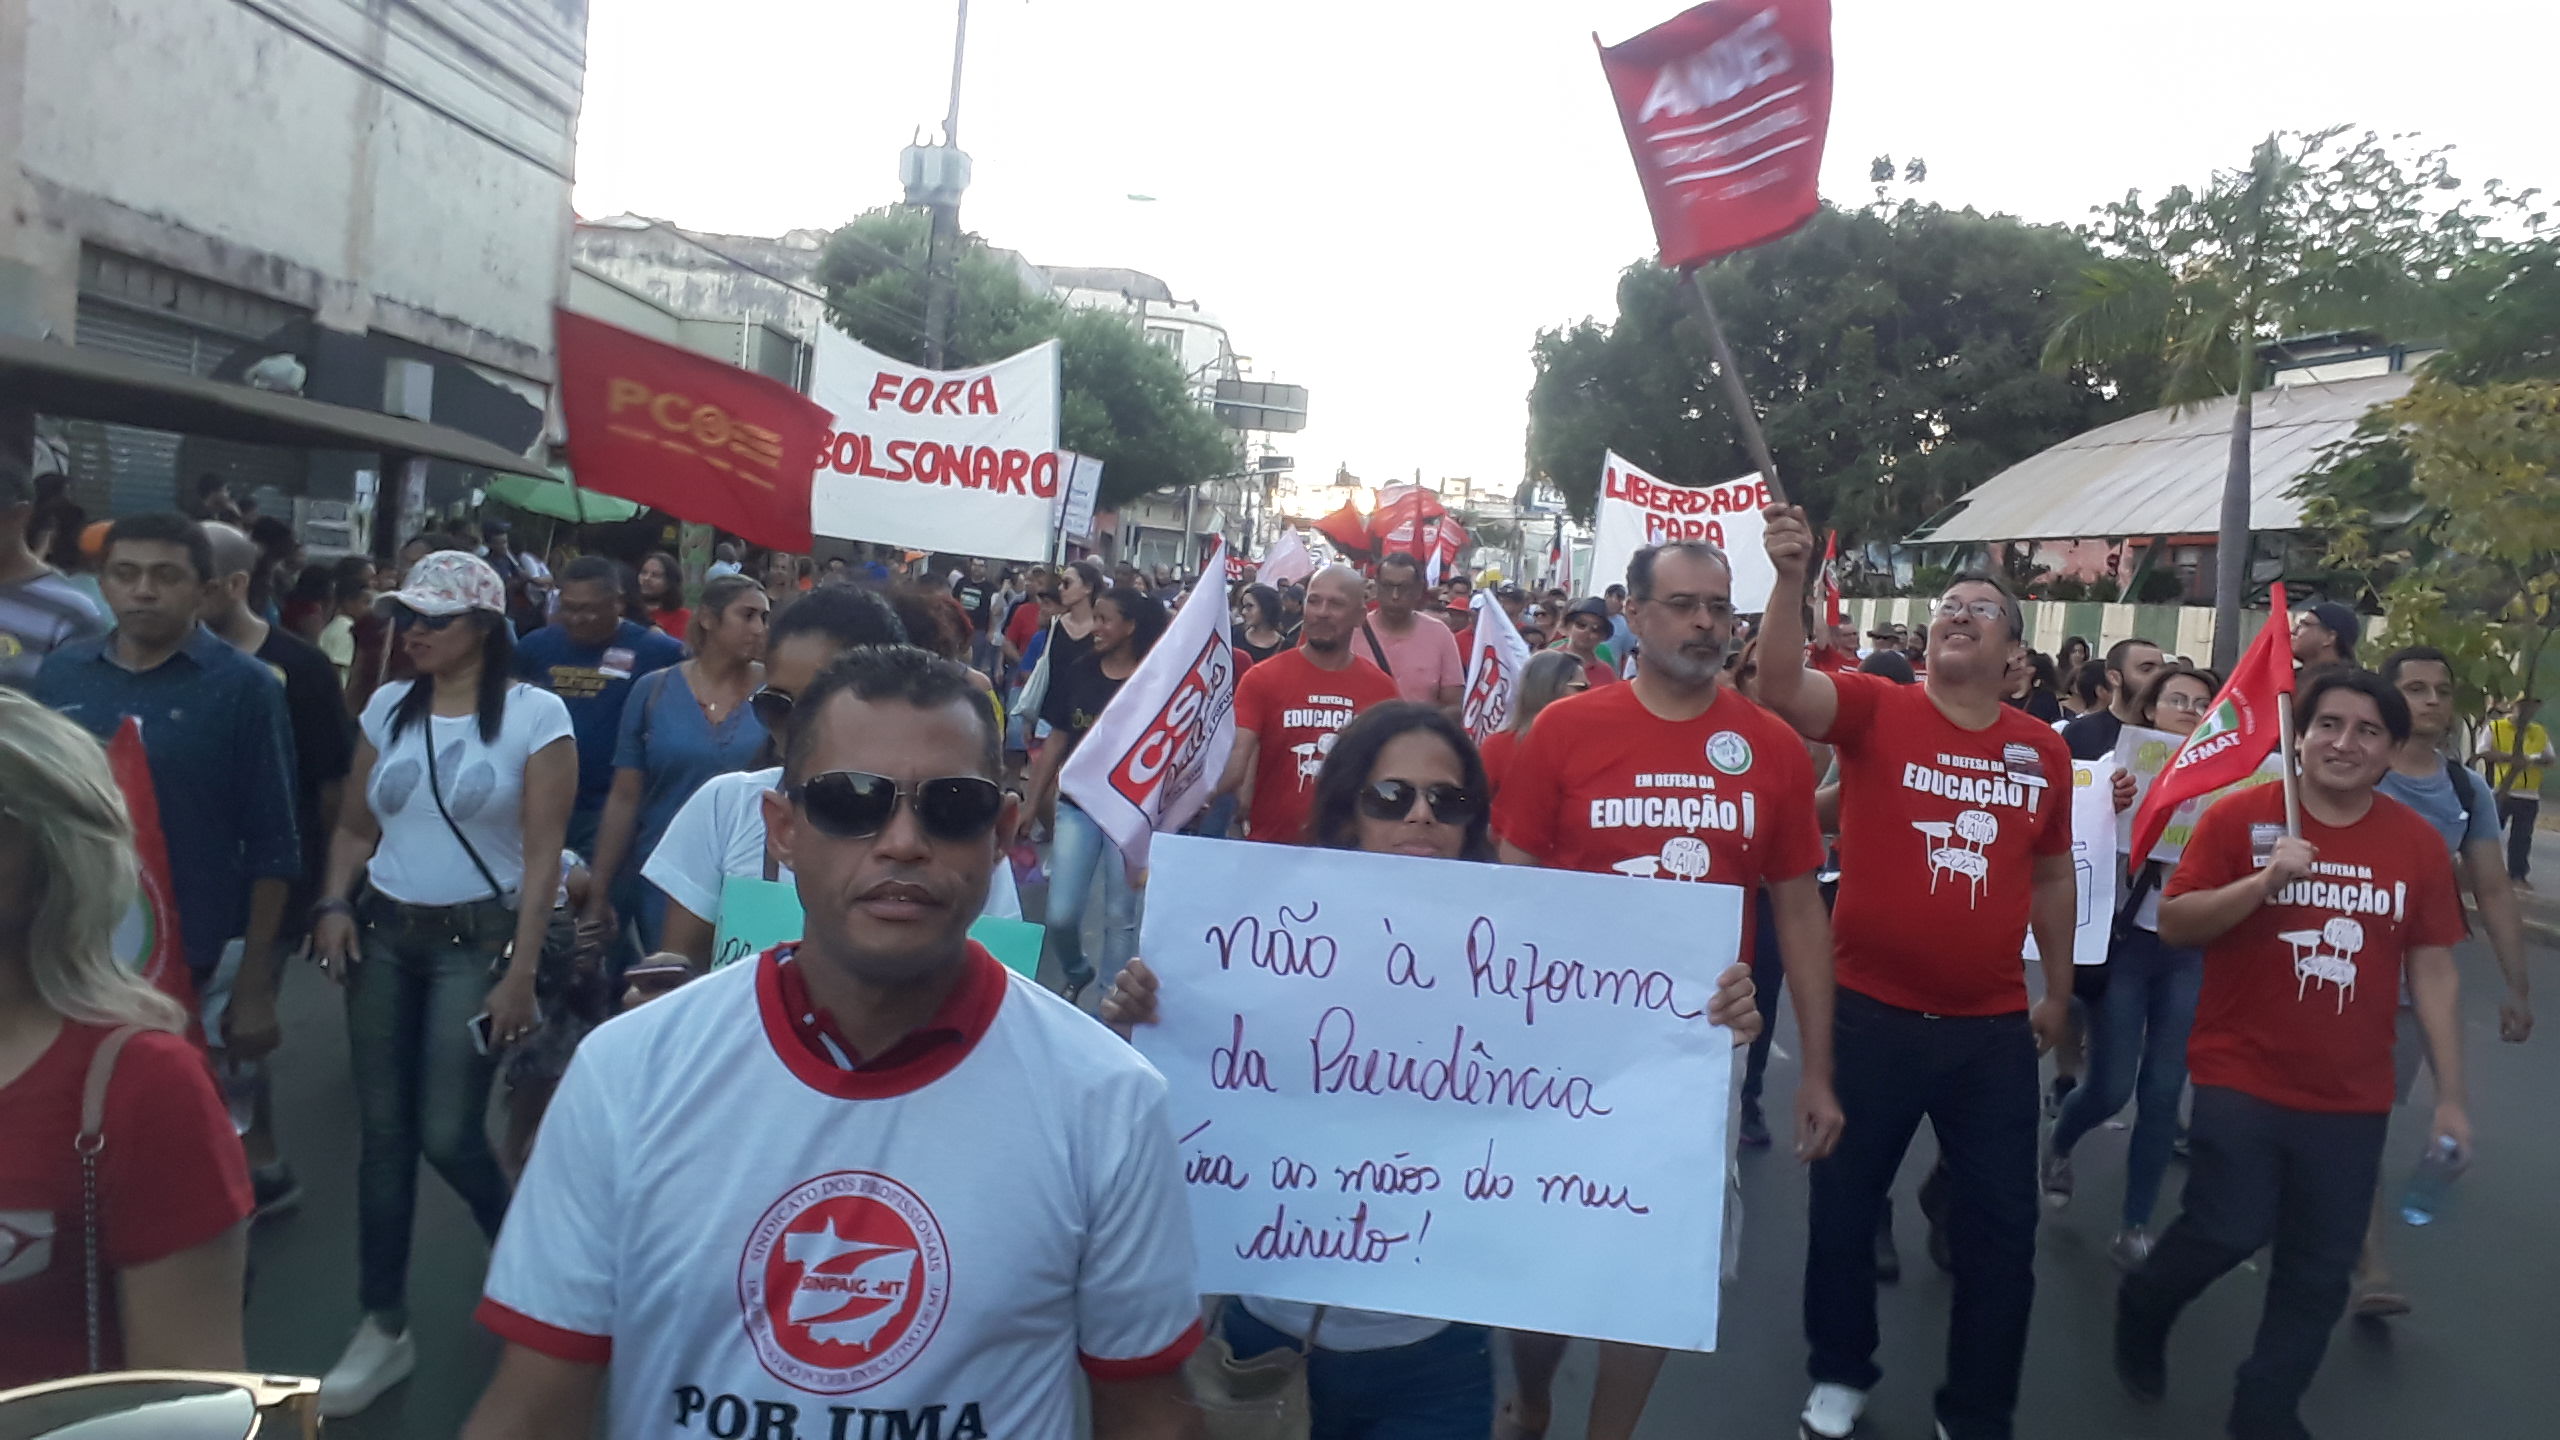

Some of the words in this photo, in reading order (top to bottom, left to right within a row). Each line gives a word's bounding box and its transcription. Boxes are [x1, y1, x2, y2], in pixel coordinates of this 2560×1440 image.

[868, 372, 999, 415] FORA
[814, 431, 1058, 499] BOLSONARO
[1605, 467, 1773, 515] LIBERDADE
[1645, 512, 1725, 550] PARA
[1283, 708, 1357, 732] EDUCAÇÃ
[1635, 774, 1652, 787] EM
[1655, 774, 1697, 788] DEFESA
[1699, 776, 1715, 789] DA
[1937, 753, 1950, 765] EM
[1951, 755, 1989, 770] DEFESA
[1991, 761, 2005, 772] DA
[2264, 880, 2407, 932] DUCAÇÃO!
[1467, 915, 1706, 1025] Reforma
[1211, 1013, 1278, 1093] da
[1309, 1006, 1612, 1119] Previdência
[1271, 1156, 1317, 1189] as
[1334, 1152, 1441, 1195] mãos
[1464, 1138, 1514, 1200] do
[1536, 1174, 1649, 1214] meu
[750, 1188, 818, 1262] SINDICATO
[821, 1178, 856, 1197] DOS
[673, 1386, 802, 1440] POR
[829, 1402, 988, 1440] UMA
